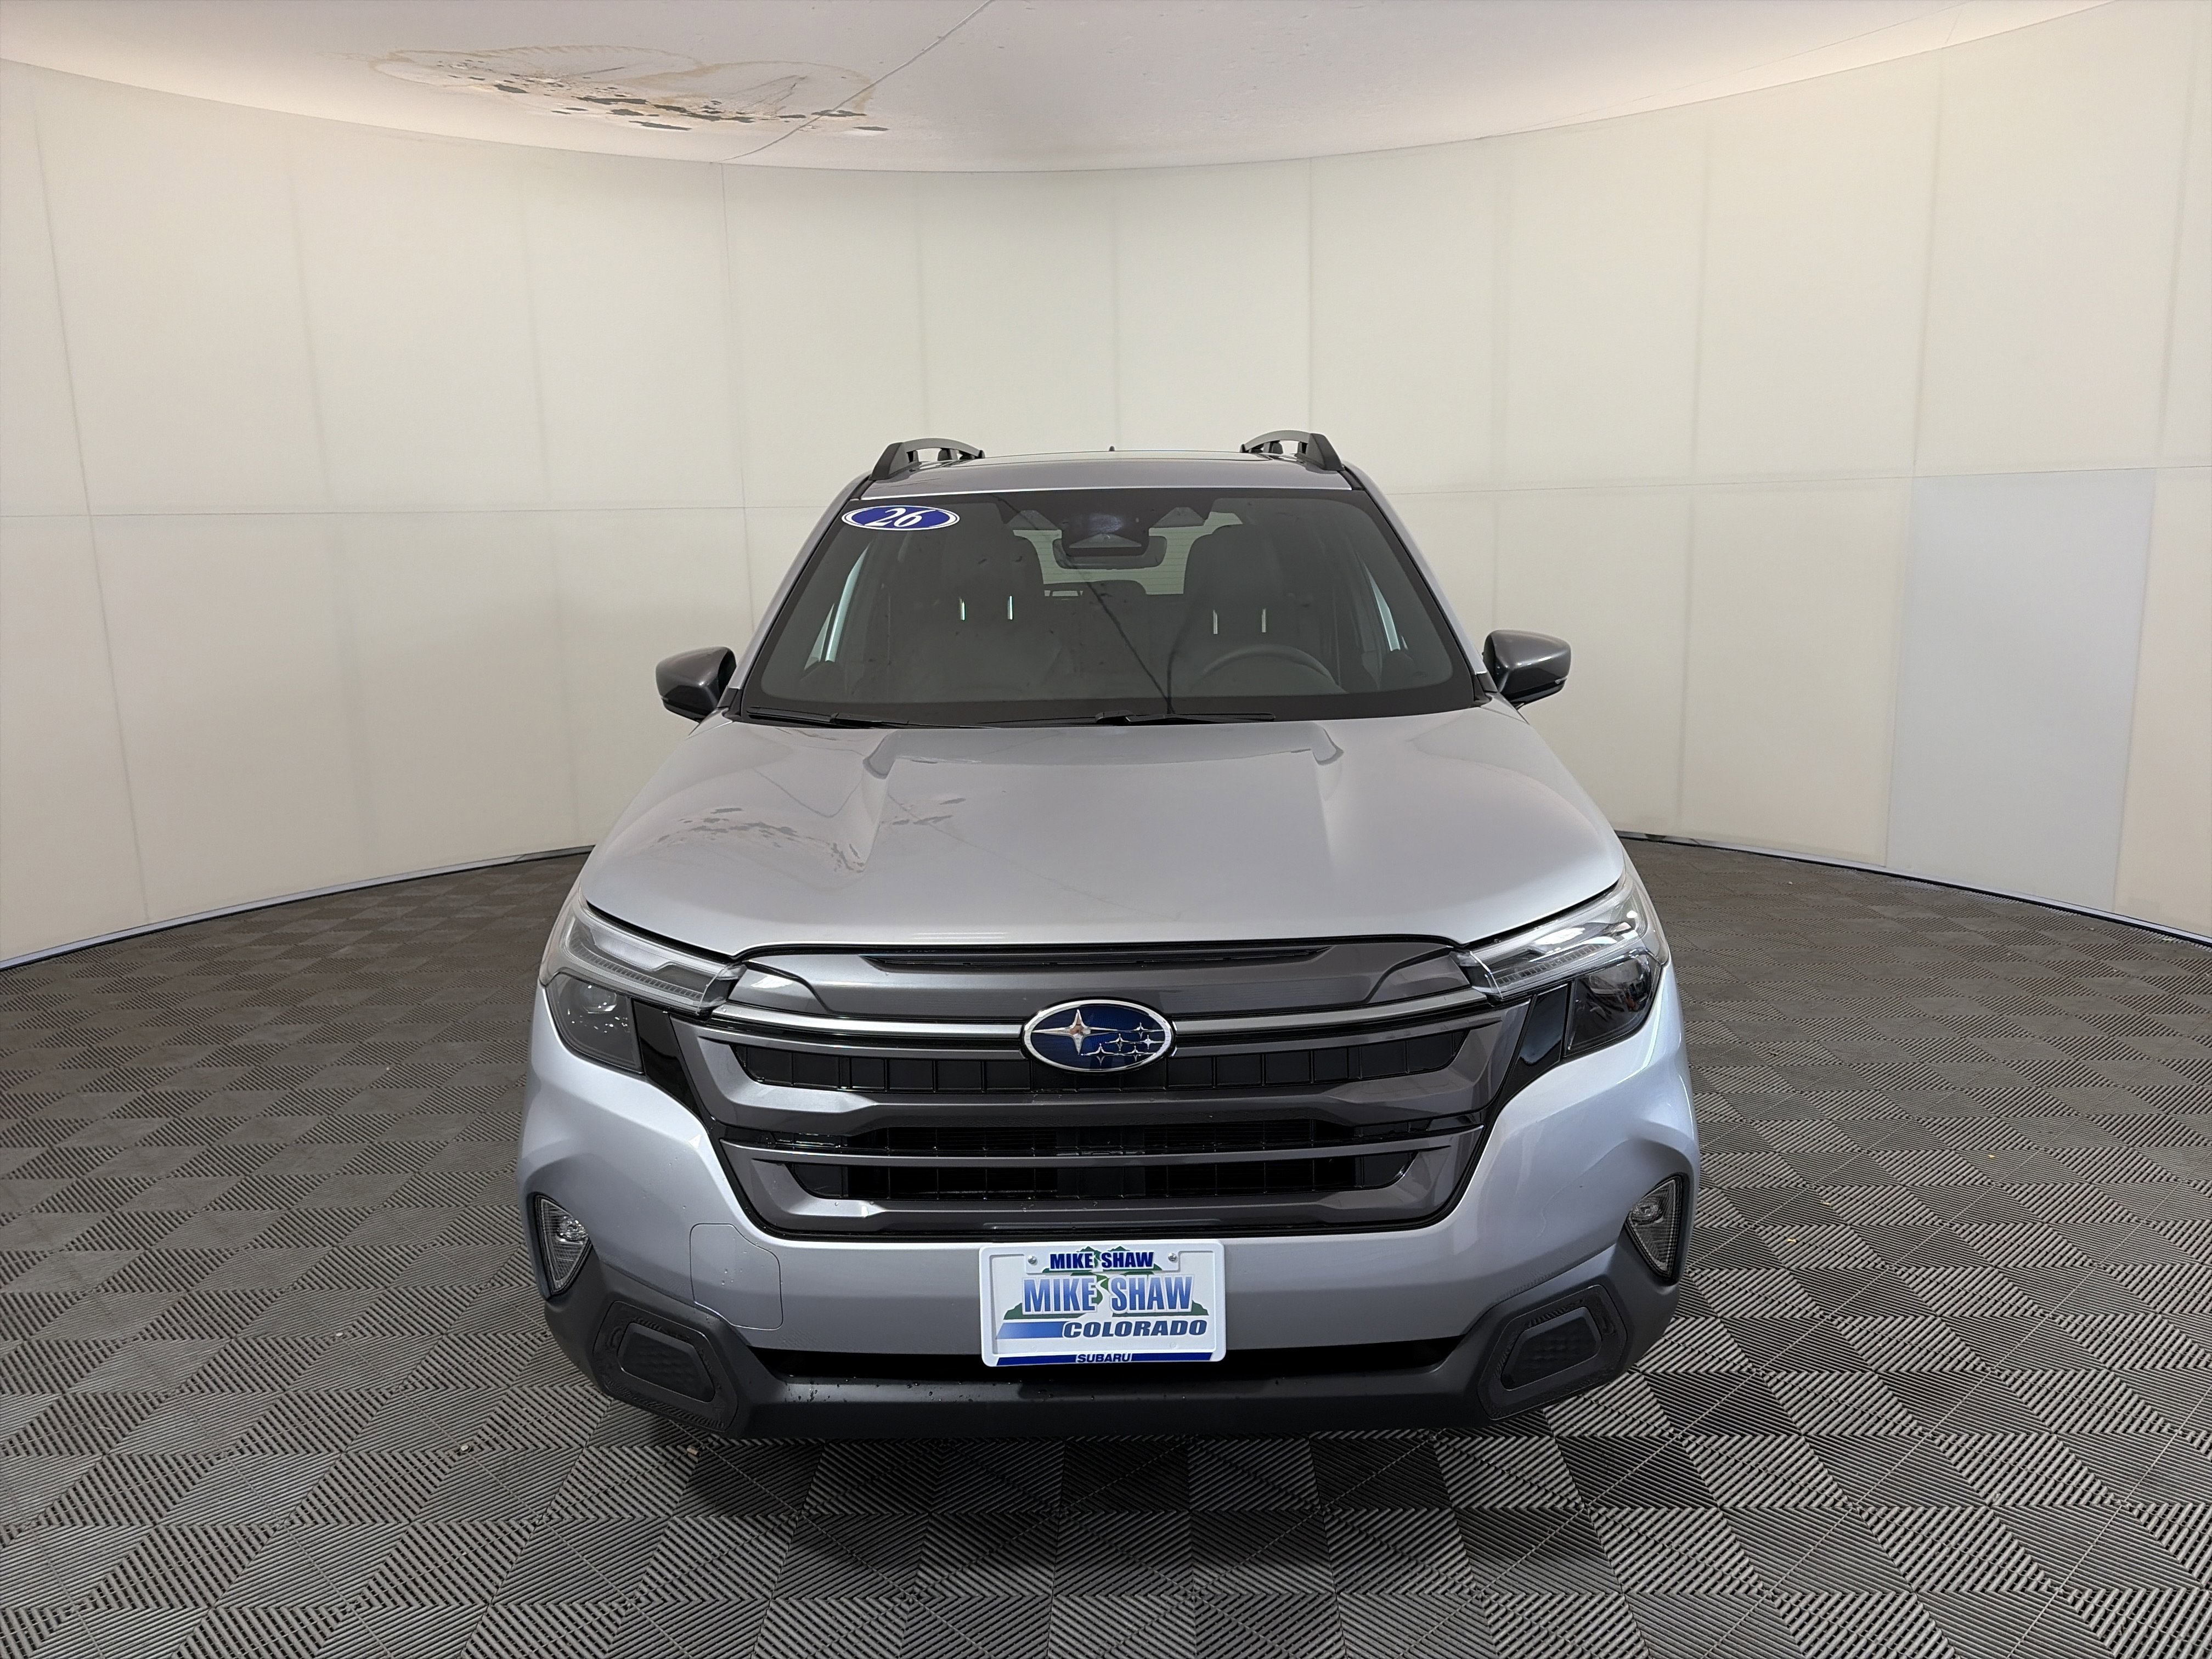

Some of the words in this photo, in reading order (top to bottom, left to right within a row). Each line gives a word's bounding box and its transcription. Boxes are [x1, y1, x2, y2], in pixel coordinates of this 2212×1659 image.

[864, 507, 936, 527] 26
[1050, 1252, 1093, 1269] MIKE
[1101, 1251, 1154, 1268] SHAW
[1024, 1278, 1096, 1312] MIKE
[1111, 1276, 1192, 1311] SHAW
[1063, 1320, 1207, 1338] COLORADO
[1077, 1353, 1131, 1363] SUBARU
